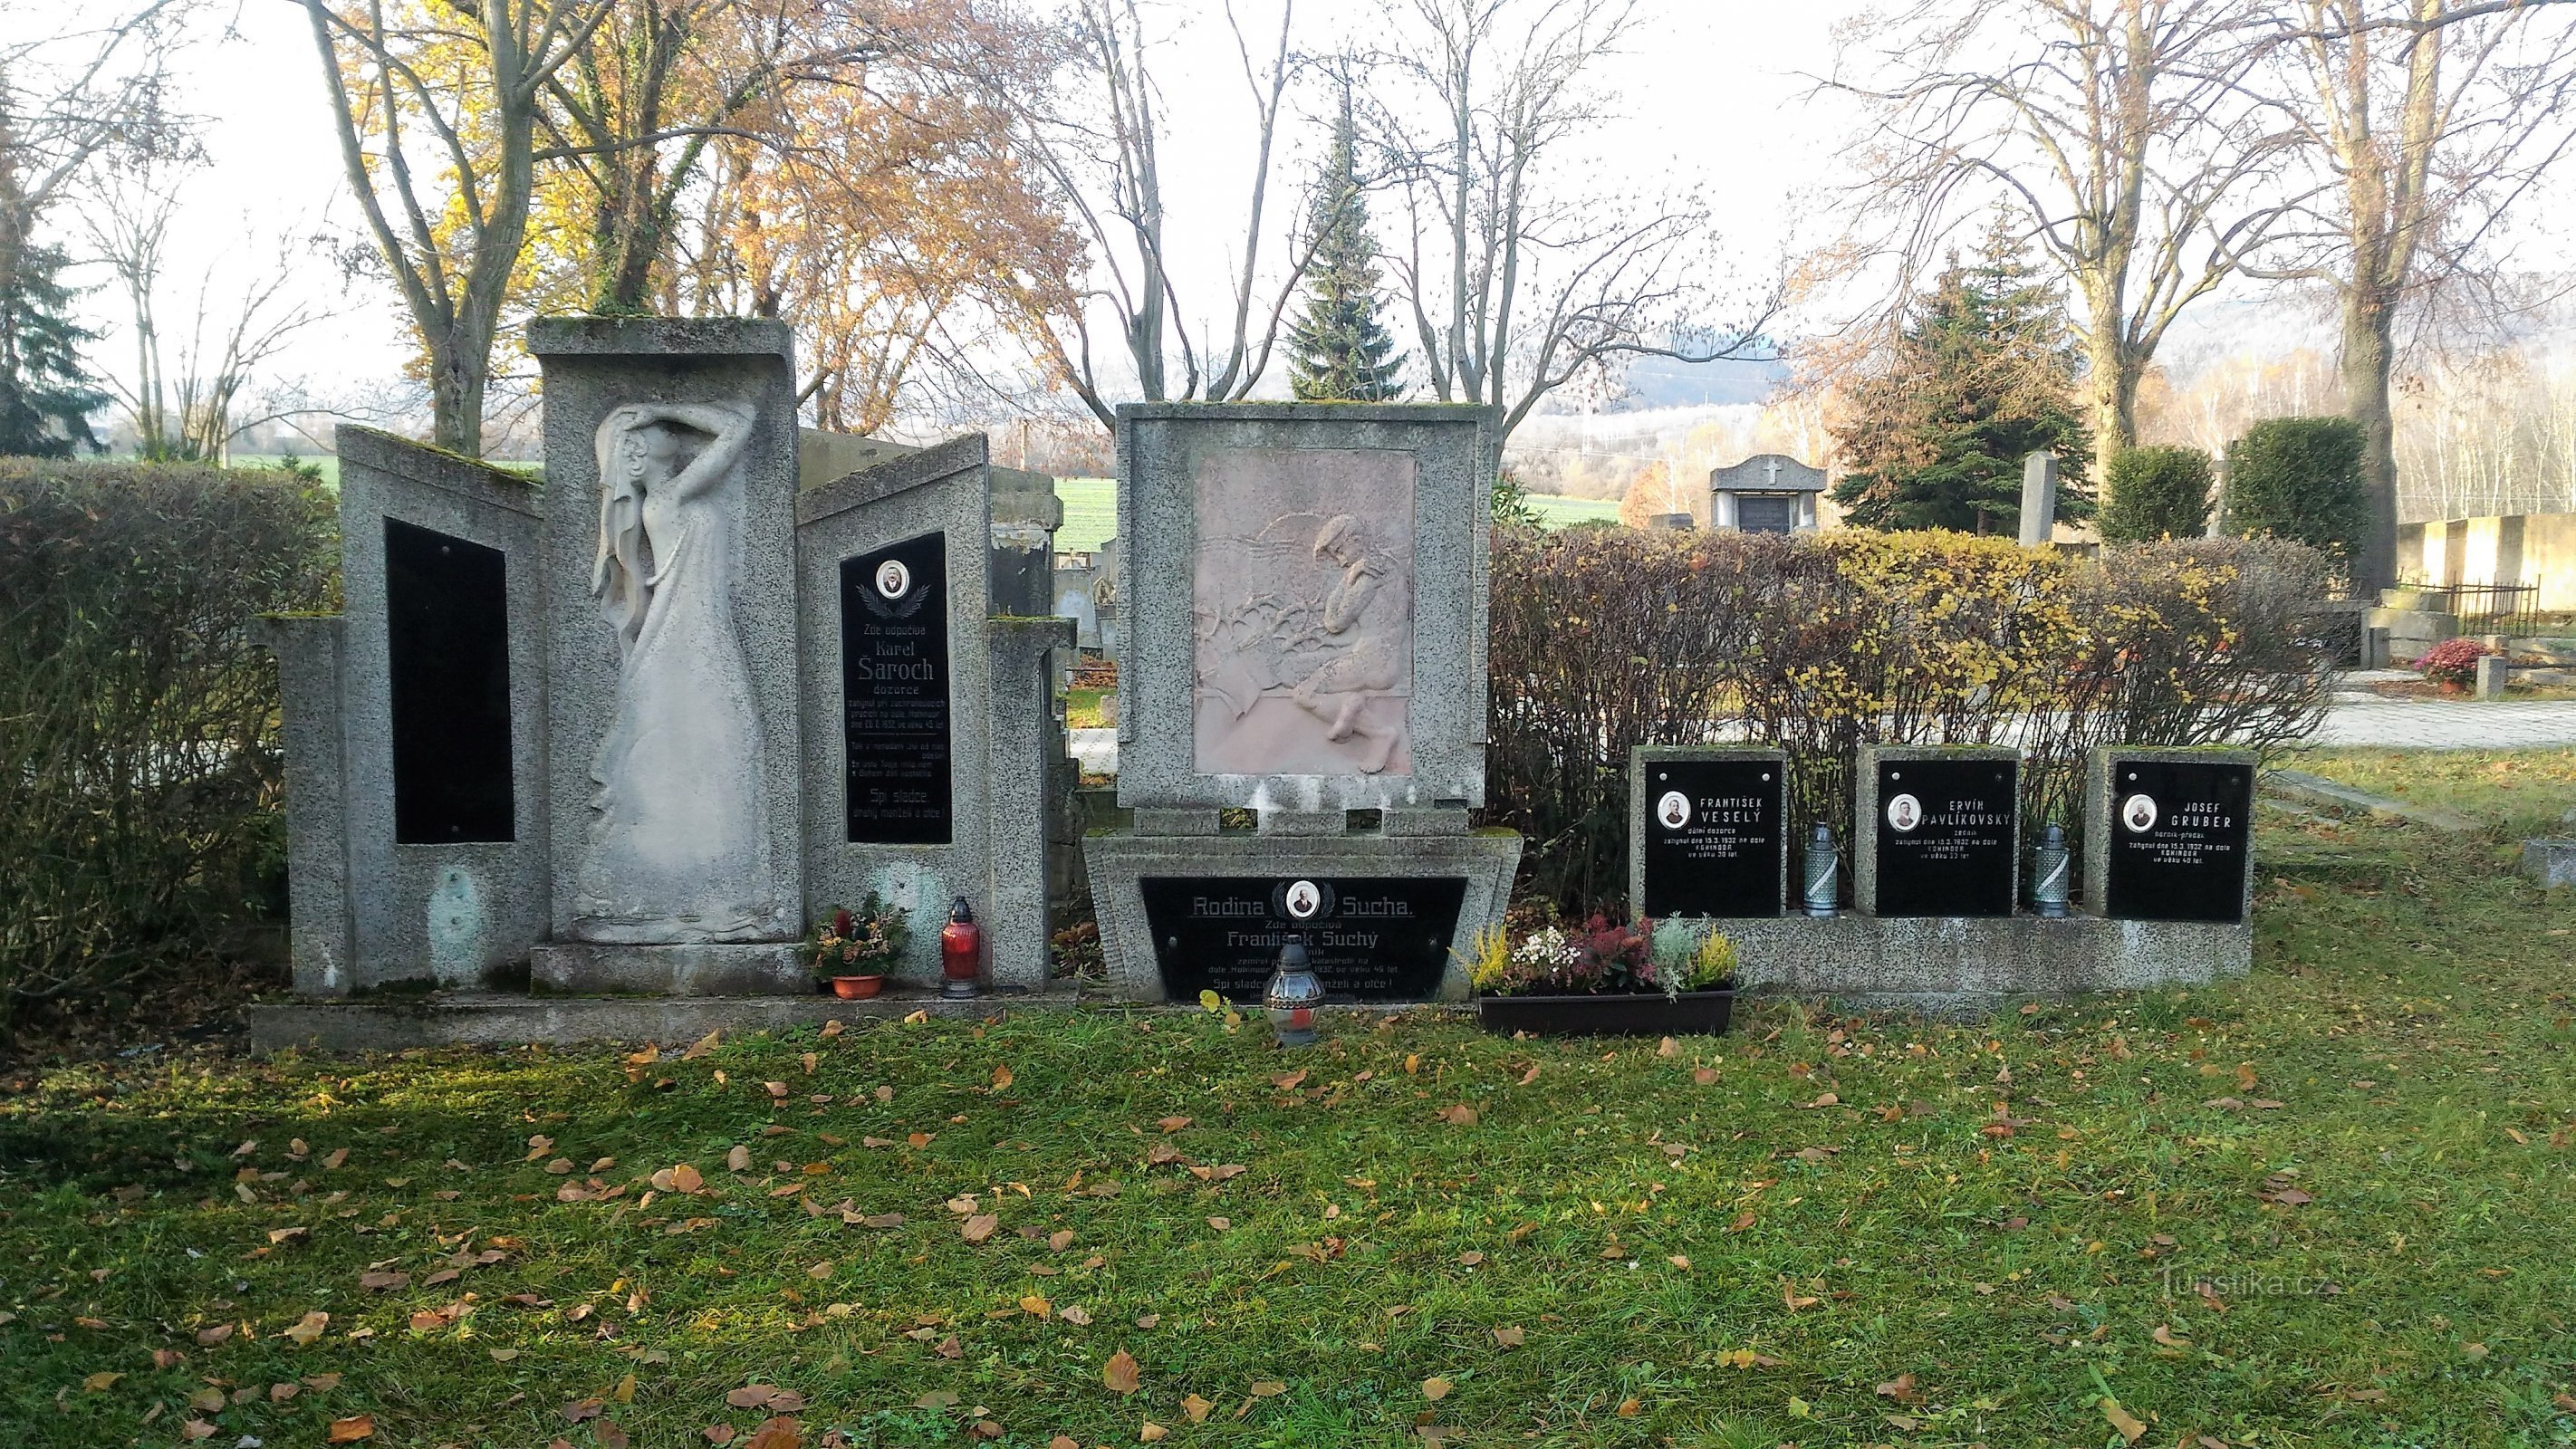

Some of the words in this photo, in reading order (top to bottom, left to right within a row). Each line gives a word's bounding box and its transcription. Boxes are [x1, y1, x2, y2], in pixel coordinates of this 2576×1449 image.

[876, 640, 915, 656] Karel
[858, 655, 934, 680] Šaroch
[873, 684, 919, 695] dozorce
[1699, 796, 1764, 808] FRANTIŠEK
[1948, 798, 1985, 811] ERVÍN
[2184, 802, 2221, 813] JOSEF
[1701, 808, 1762, 823] VESELÝ
[1920, 811, 2011, 825] PAVLÍKOVSKÝ
[2170, 814, 2231, 828] GRUBER
[1193, 897, 1265, 916] Rodina
[1264, 920, 1286, 929] Zde
[1226, 931, 1314, 947] Františk
[1322, 931, 1379, 949] Suchý
[1353, 981, 1360, 989] a
